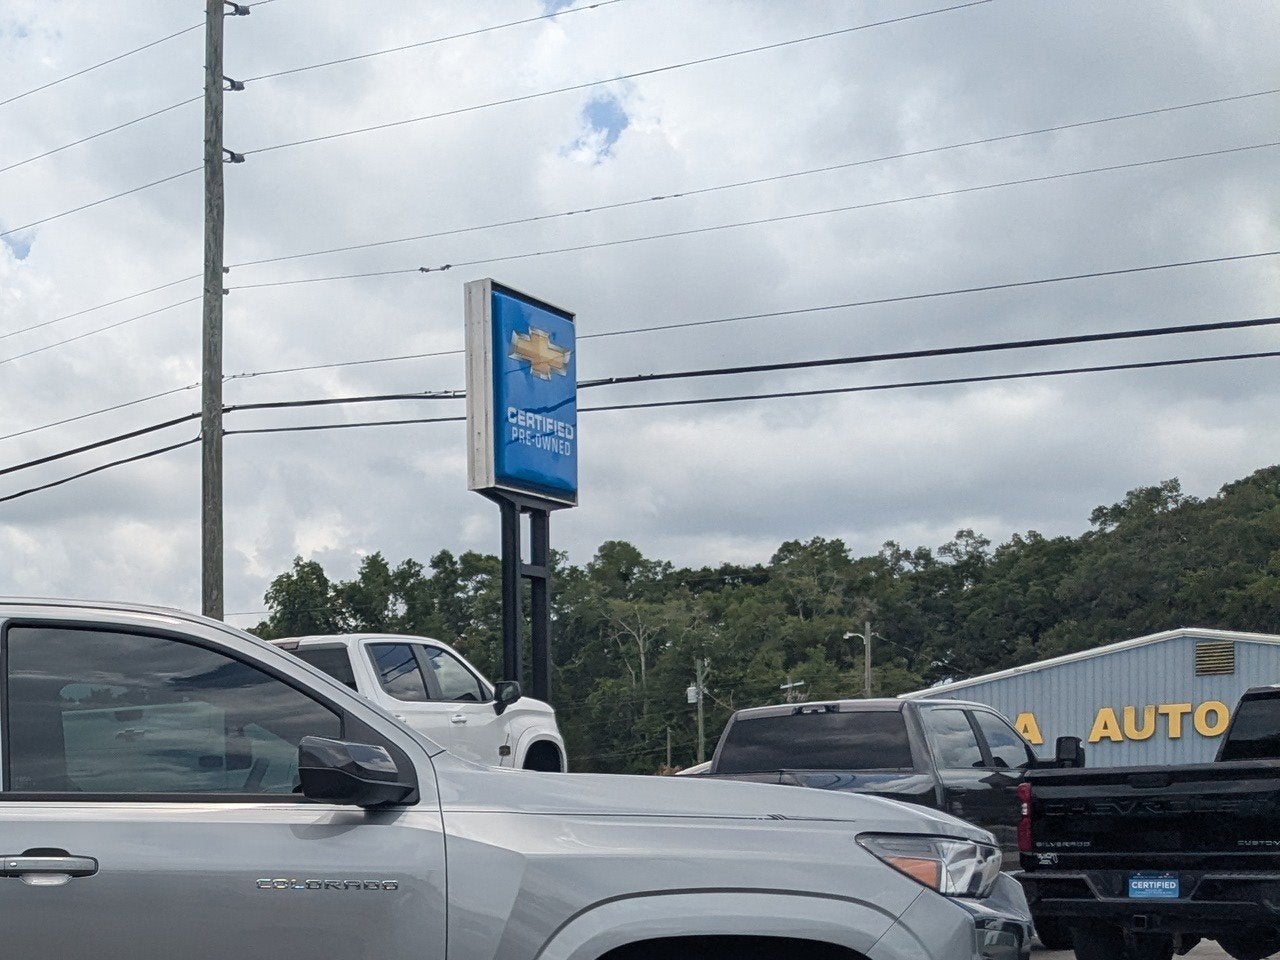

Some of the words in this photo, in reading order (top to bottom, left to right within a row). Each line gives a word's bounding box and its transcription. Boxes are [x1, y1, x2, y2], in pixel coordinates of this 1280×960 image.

[507, 406, 574, 440] CERTIFIED
[511, 427, 571, 456] PRE-OWNED
[1088, 700, 1230, 743] AUTO
[256, 878, 399, 891] COLORADO
[1131, 881, 1177, 889] CERTIFIED
